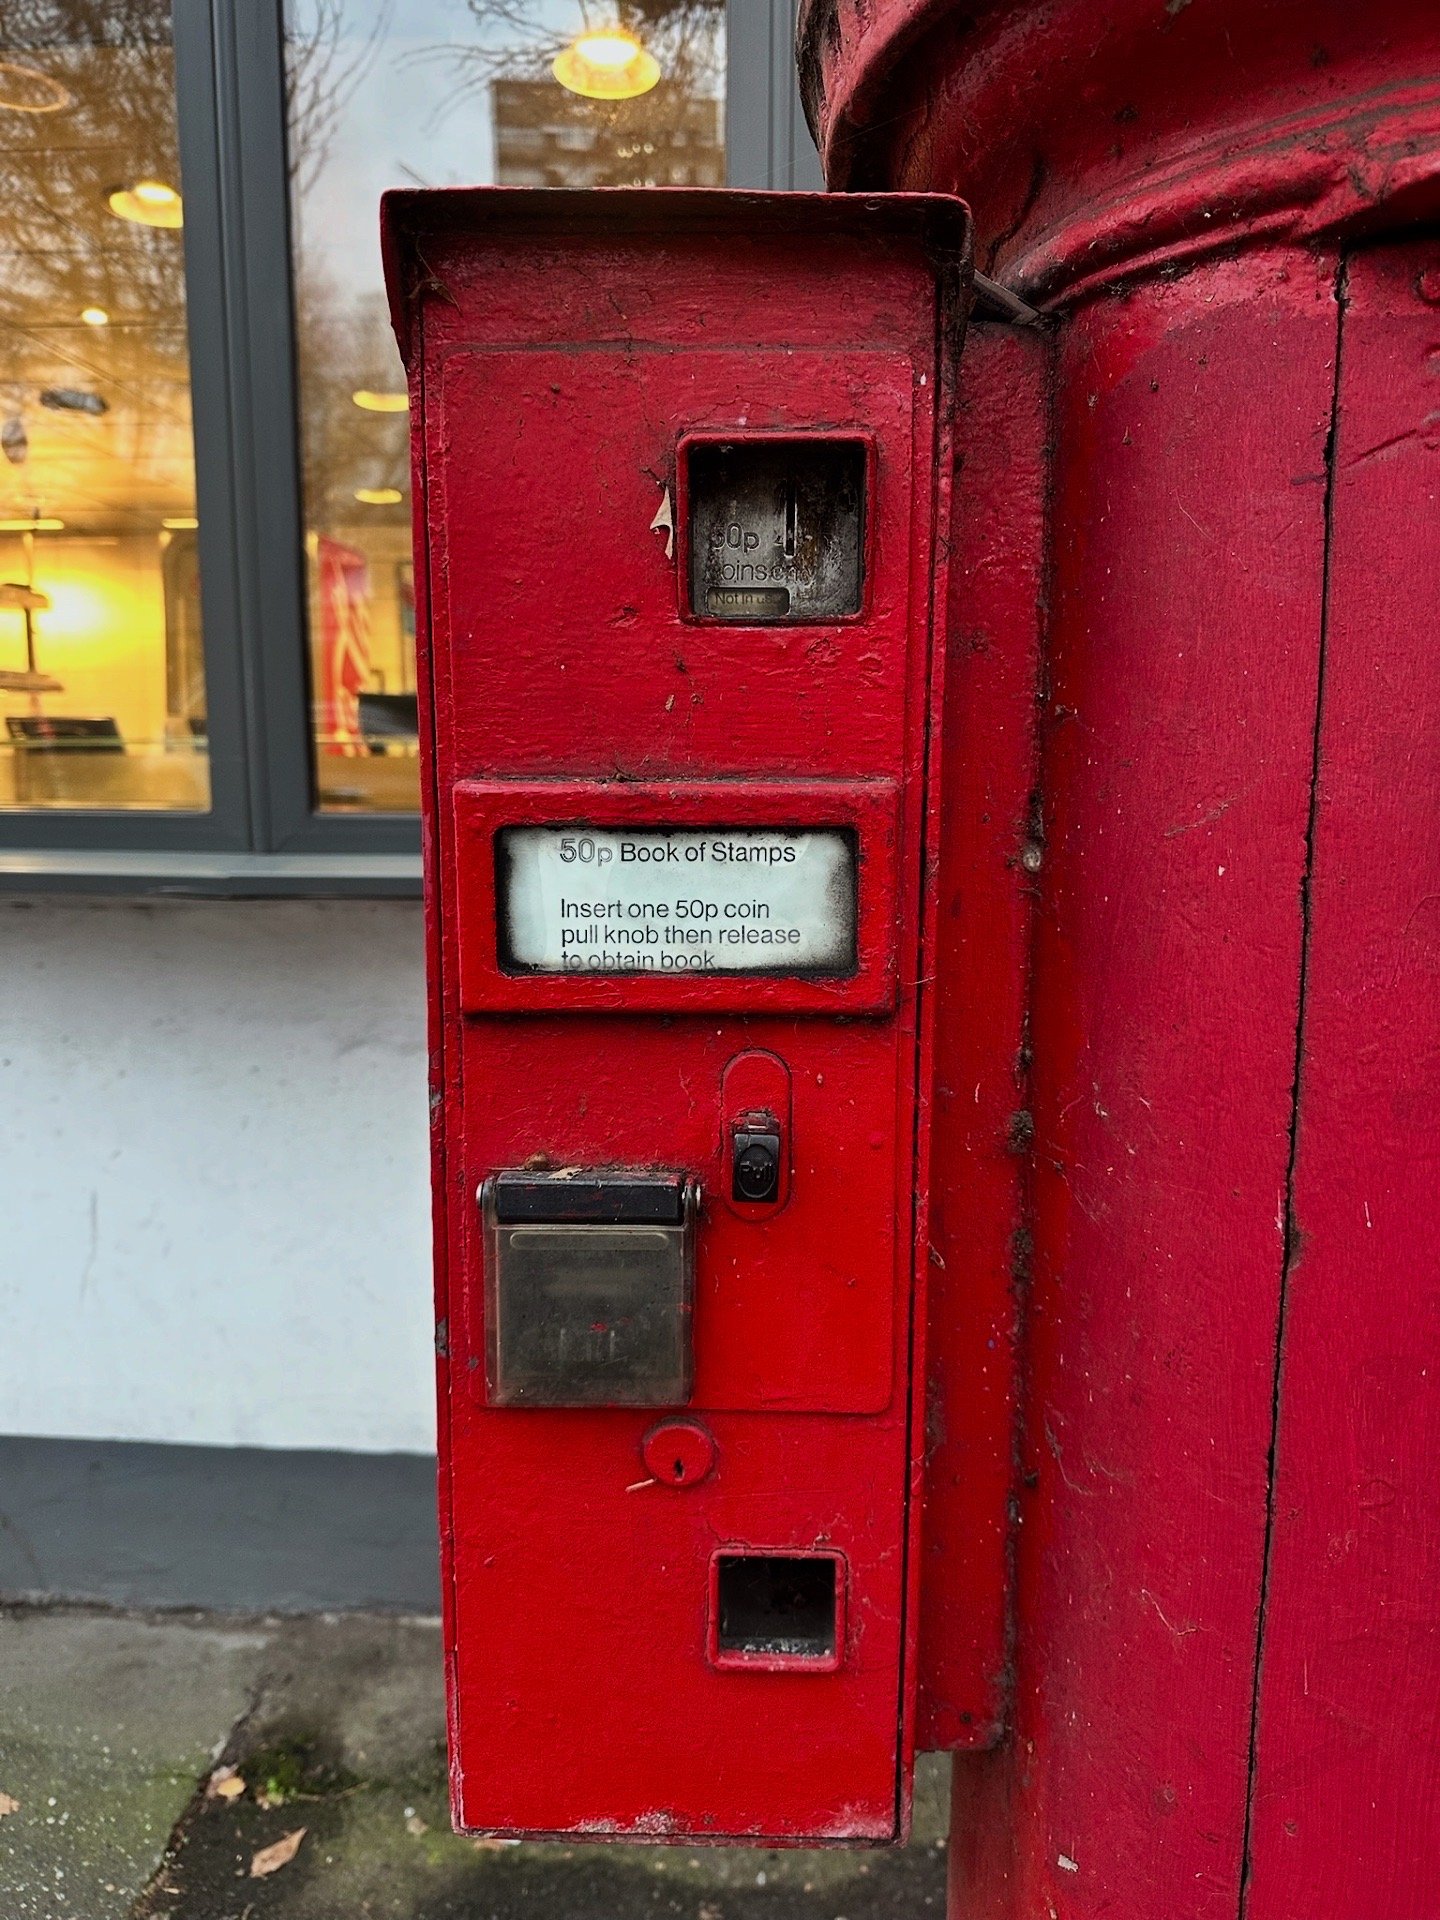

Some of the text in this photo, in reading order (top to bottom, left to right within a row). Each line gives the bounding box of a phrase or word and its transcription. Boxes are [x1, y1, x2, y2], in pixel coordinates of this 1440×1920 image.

[711, 560, 768, 581] oins
[715, 591, 739, 605] Not
[559, 838, 796, 867] 50p Book of Stamps
[561, 898, 770, 922] Insert one 50p coin
[561, 924, 801, 947] pull knob then release
[561, 950, 715, 969] to obtain book
